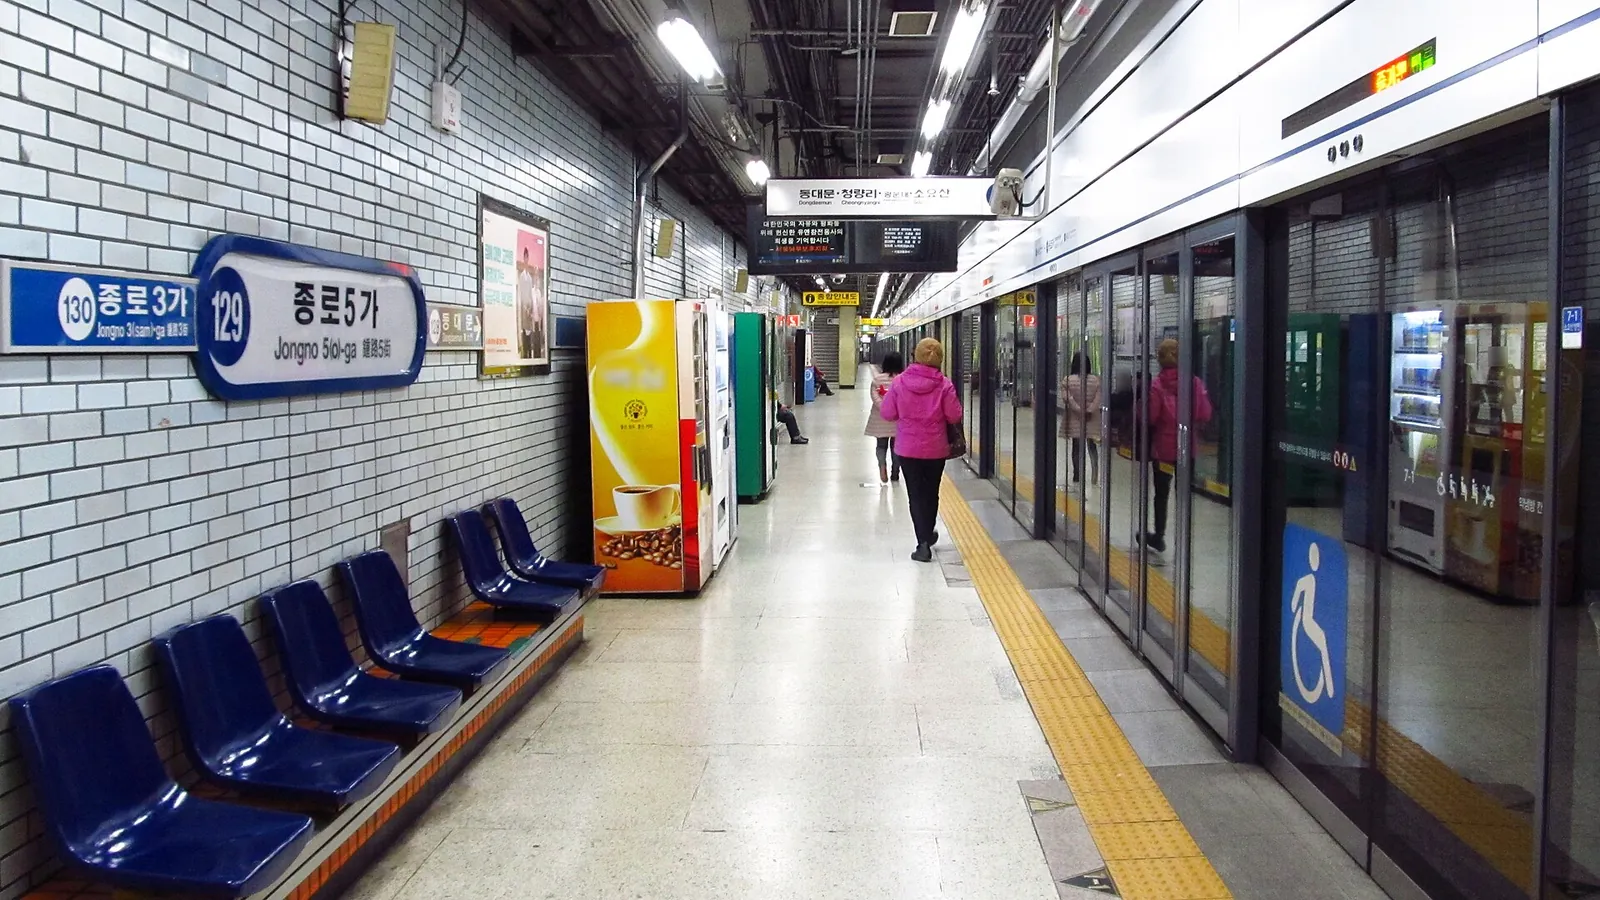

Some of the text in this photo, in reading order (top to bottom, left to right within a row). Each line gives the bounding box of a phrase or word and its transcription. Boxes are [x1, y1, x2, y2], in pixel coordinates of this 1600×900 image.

[763, 220, 796, 228] 대한민국의
[63, 295, 92, 324] 130
[98, 283, 188, 318] 종로3가
[293, 281, 379, 329] 종로5가
[211, 290, 243, 343] 129
[1567, 310, 1578, 322] 7-1
[96, 322, 125, 341] Jongno
[274, 336, 357, 365] Jongno 5(o)-ga
[1404, 468, 1415, 484] 7-1
